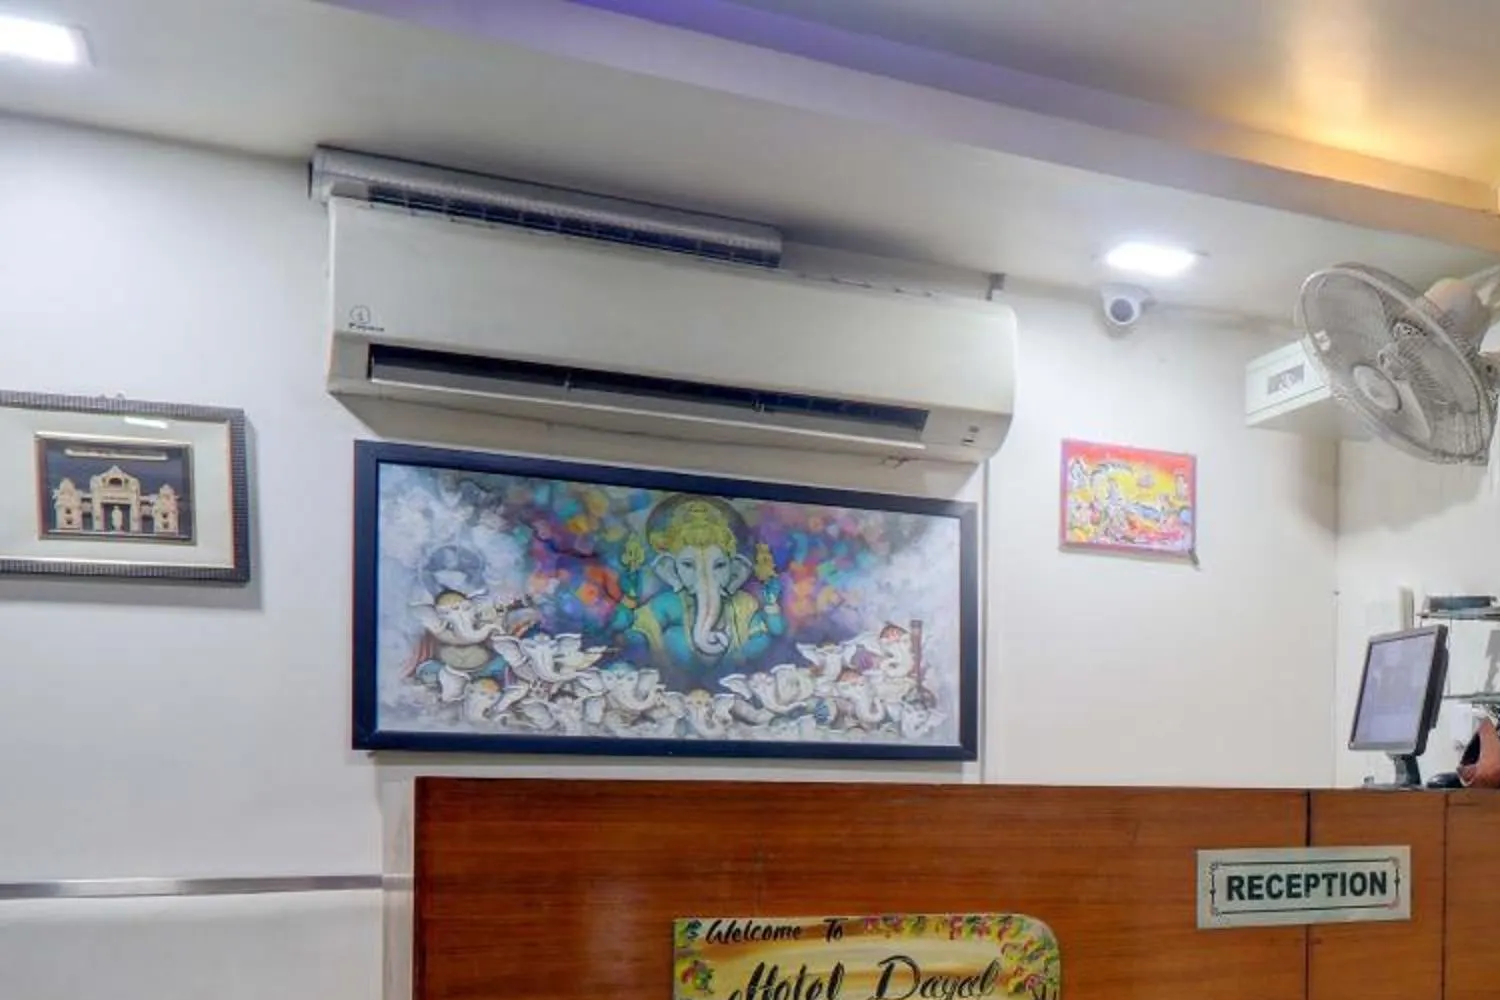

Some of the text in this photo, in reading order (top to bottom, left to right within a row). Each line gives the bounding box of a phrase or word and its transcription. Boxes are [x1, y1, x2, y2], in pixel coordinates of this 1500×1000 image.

[1226, 871, 1388, 901] RECEPTION
[705, 917, 849, 945] Welcome To
